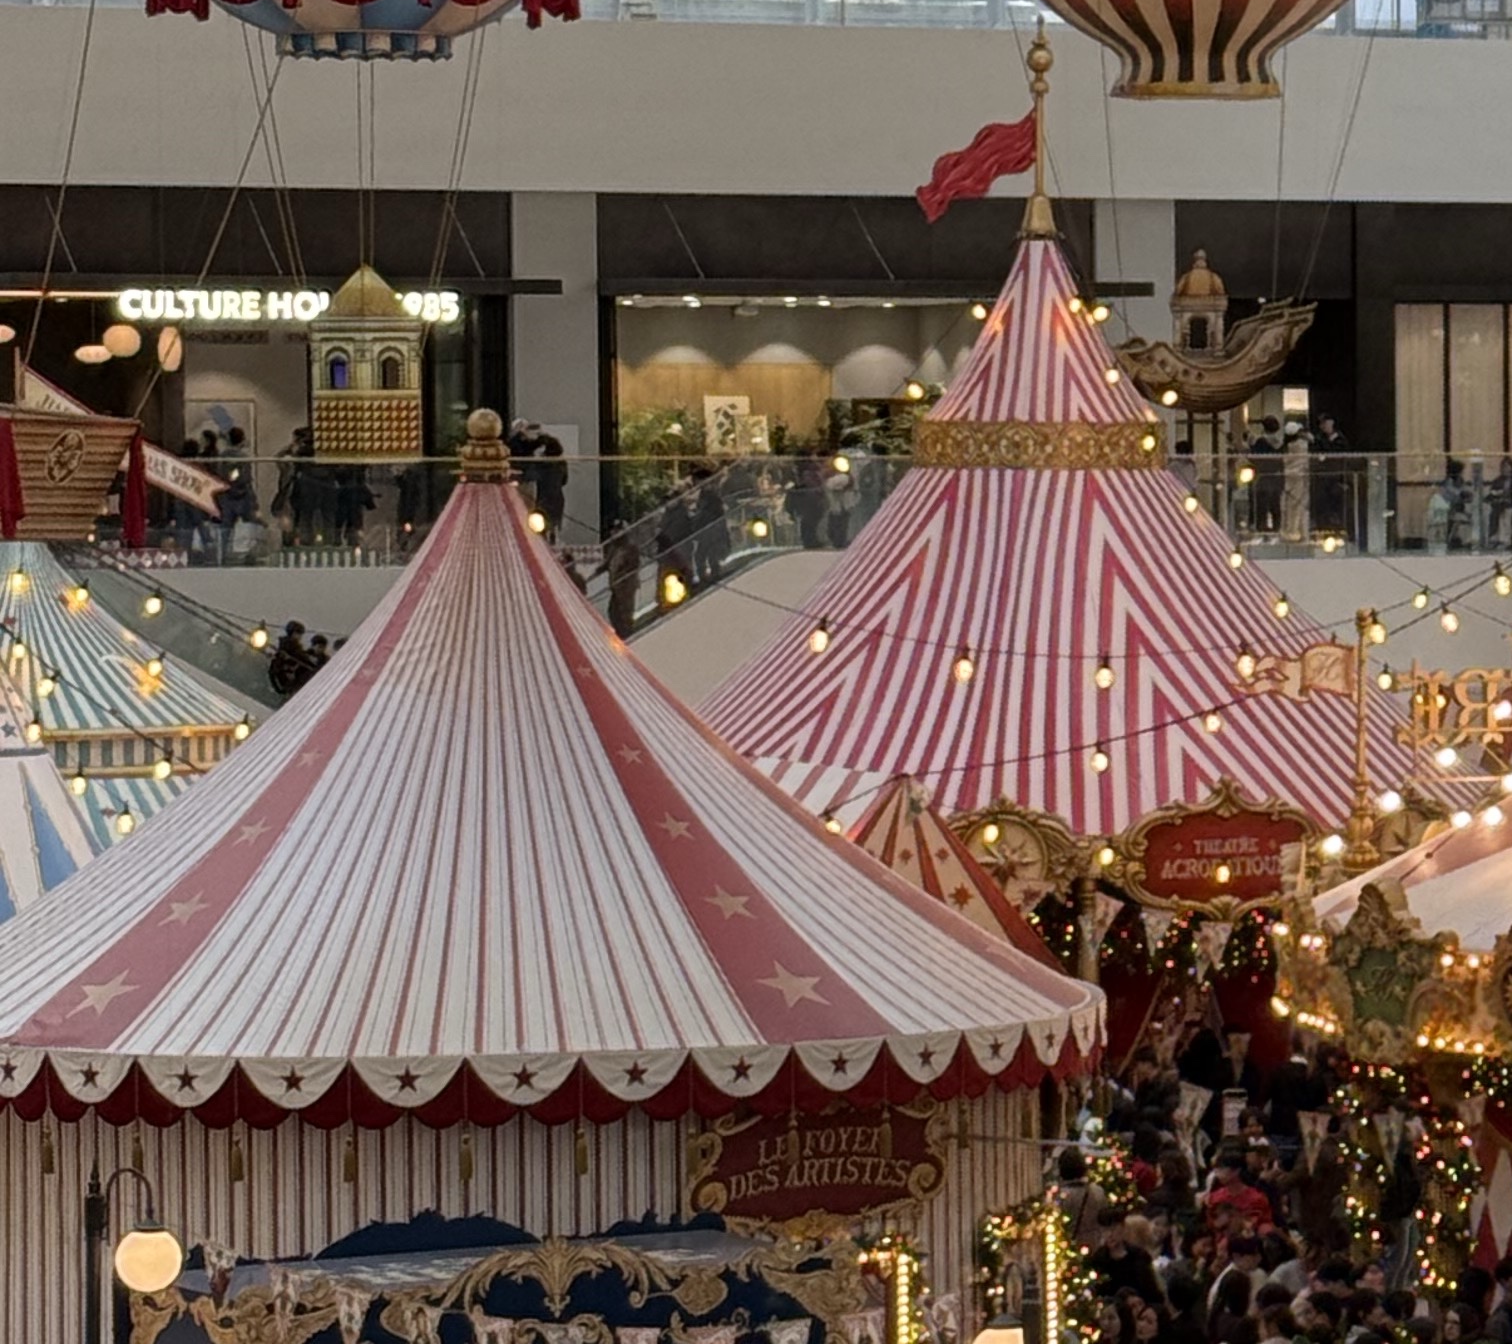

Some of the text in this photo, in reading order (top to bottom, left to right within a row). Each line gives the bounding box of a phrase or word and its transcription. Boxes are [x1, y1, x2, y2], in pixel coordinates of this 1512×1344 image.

[119, 289, 261, 320] CULTURE
[395, 291, 460, 322] 985
[729, 1155, 912, 1202] DES ARTISTES
